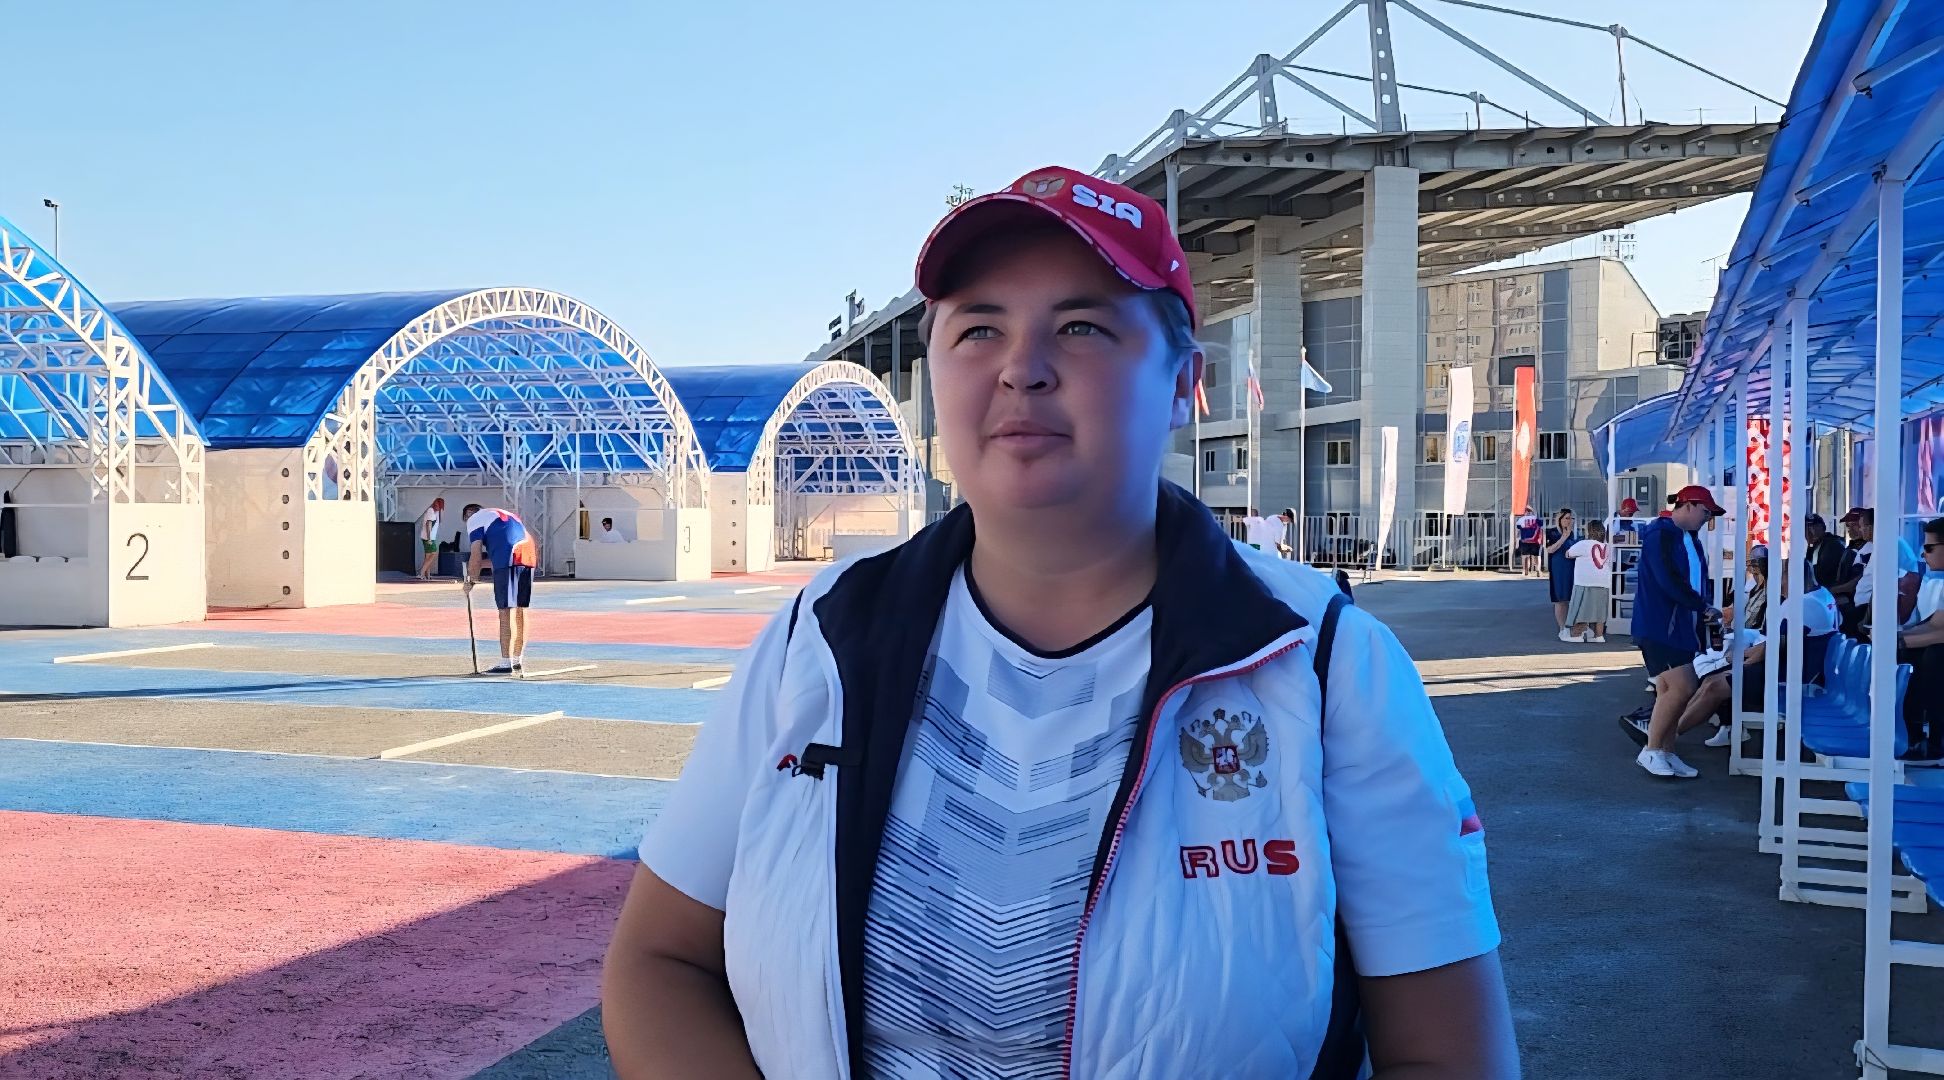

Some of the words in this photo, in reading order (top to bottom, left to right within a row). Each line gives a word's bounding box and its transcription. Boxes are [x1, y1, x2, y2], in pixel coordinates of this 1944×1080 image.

[1072, 184, 1142, 229] SIA
[126, 533, 149, 580] 2
[1180, 838, 1300, 879] RUS
